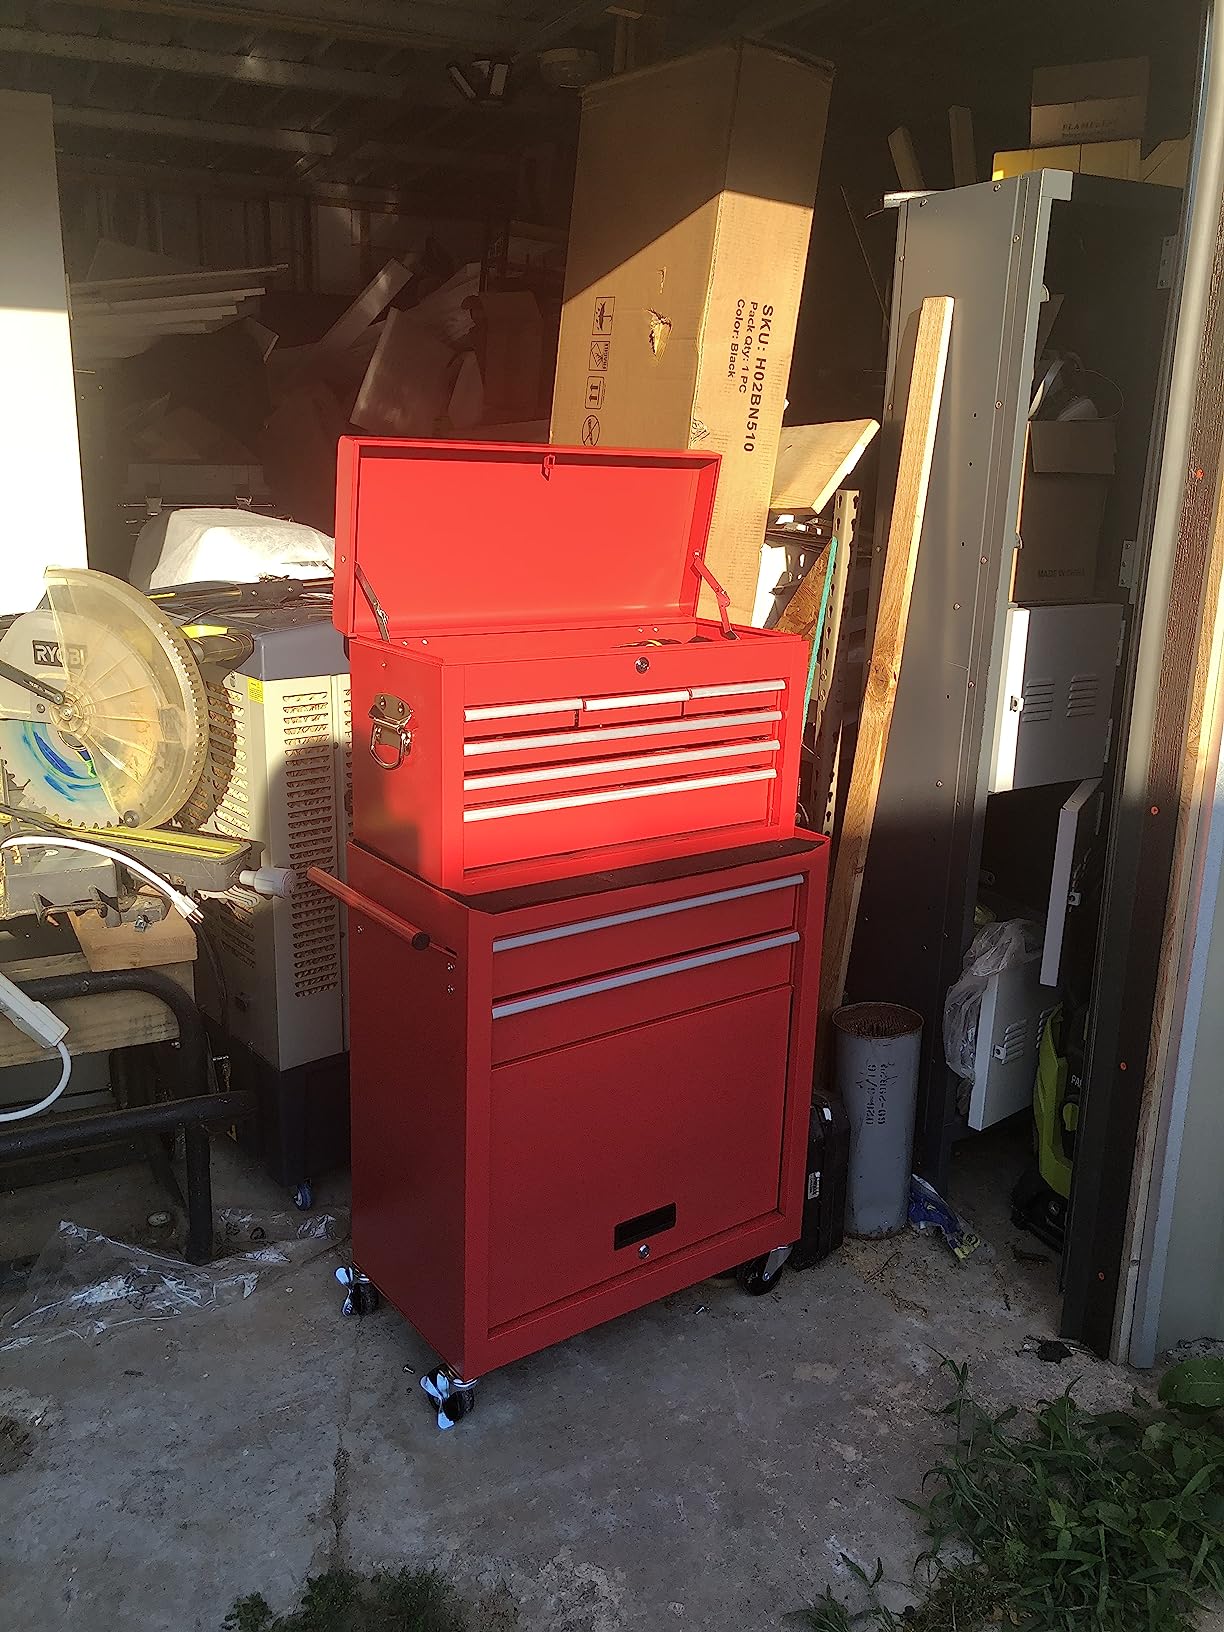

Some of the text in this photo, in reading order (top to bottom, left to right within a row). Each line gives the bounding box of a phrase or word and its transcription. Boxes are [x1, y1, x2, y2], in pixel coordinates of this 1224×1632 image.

[748, 301, 758, 333] Pack
[727, 298, 746, 378] Color: Black
[741, 335, 753, 362] Qty:
[739, 375, 748, 394] PC
[743, 304, 774, 452] SKU: H02BN510
